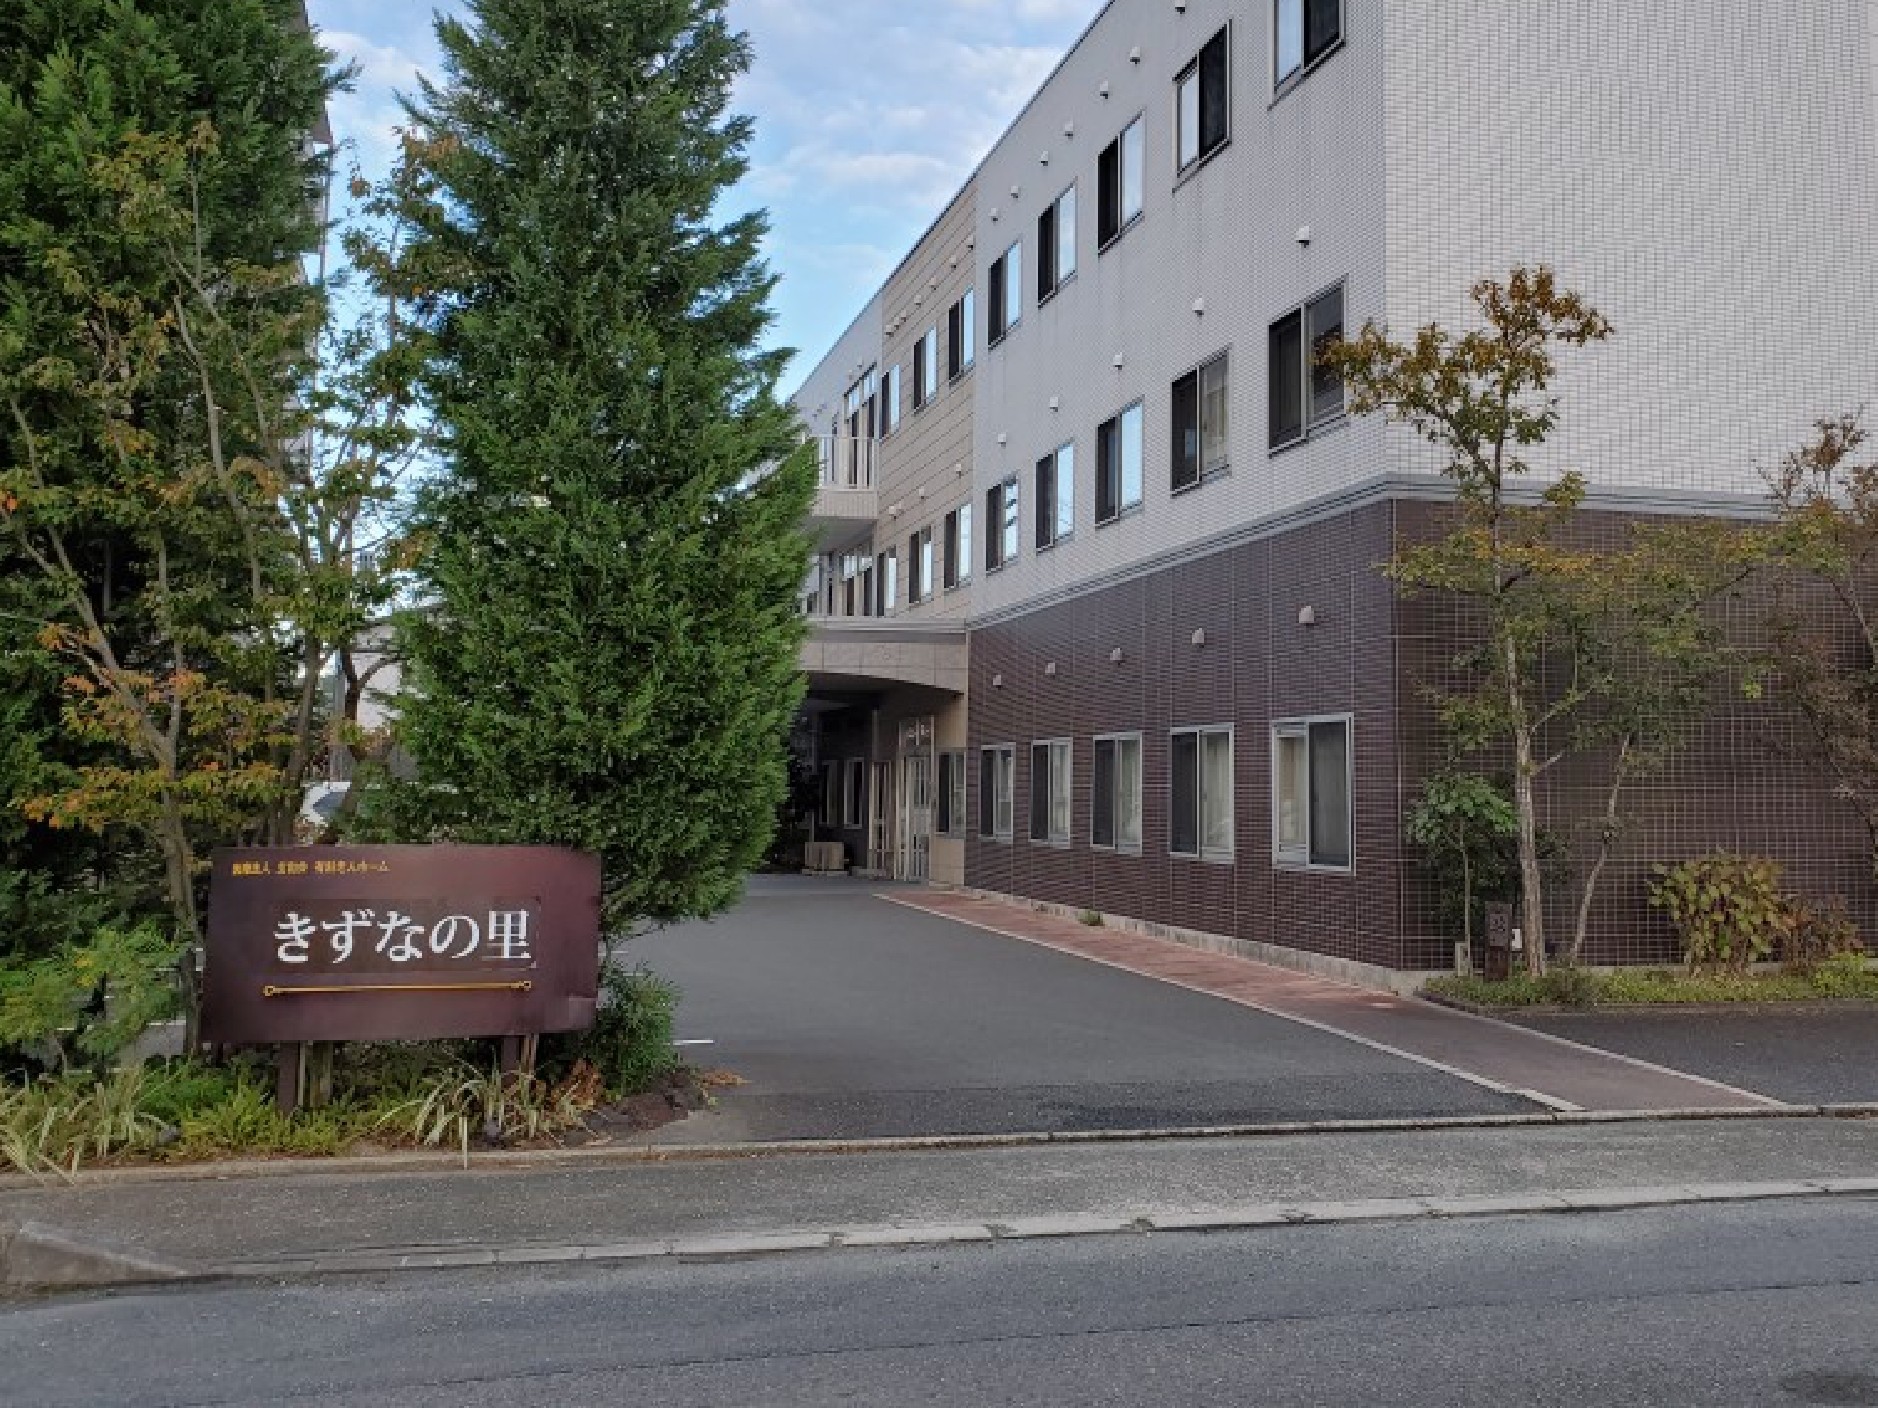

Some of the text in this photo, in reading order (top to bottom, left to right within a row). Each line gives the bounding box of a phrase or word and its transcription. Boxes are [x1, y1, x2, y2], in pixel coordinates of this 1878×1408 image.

[273, 908, 532, 964] きずなの里
